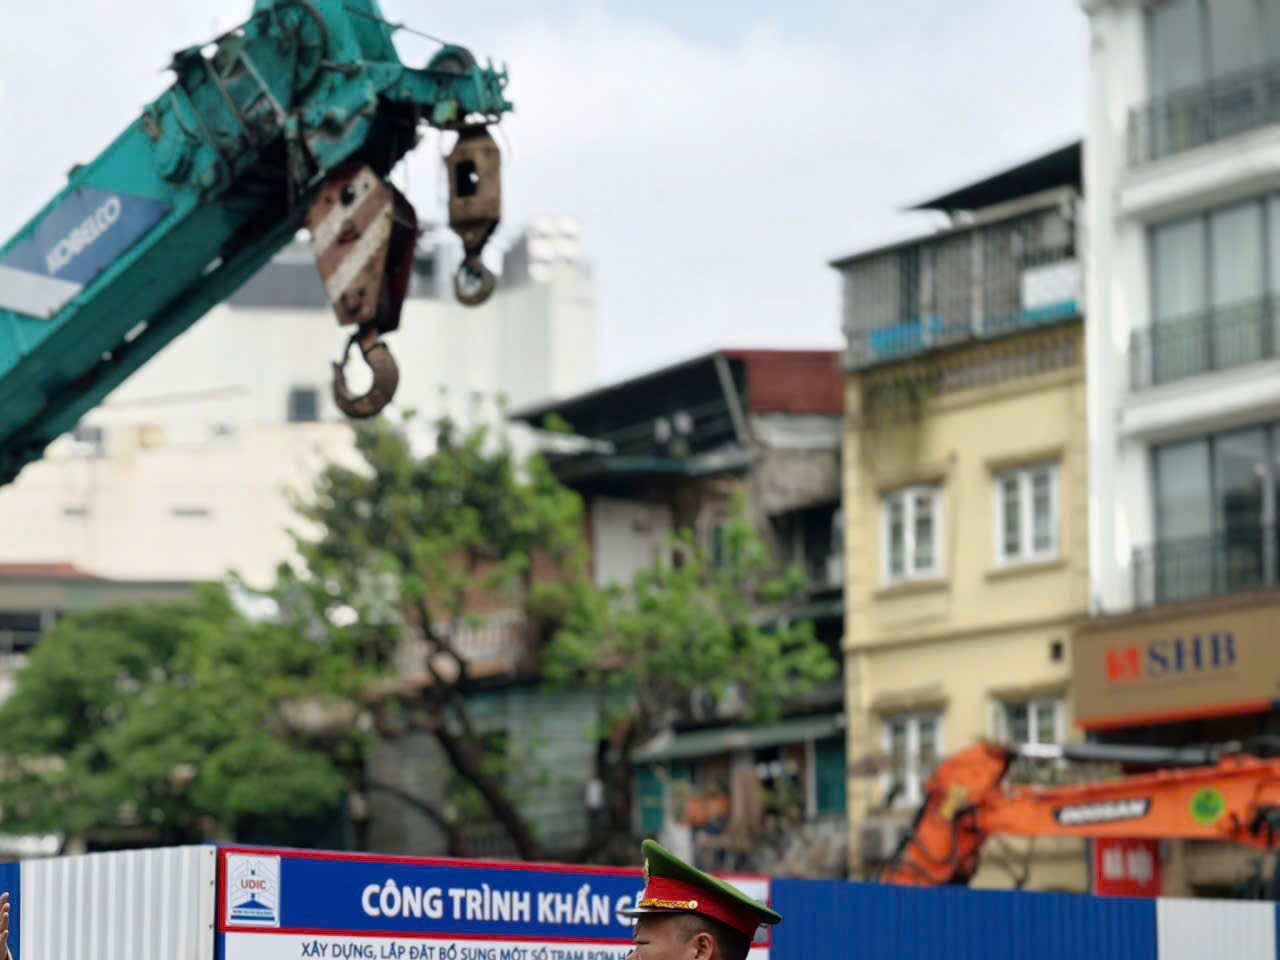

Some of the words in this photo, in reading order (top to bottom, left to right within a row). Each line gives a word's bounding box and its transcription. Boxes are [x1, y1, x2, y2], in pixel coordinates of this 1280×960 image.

[46, 196, 122, 273] KOBELCO
[1147, 631, 1236, 677] SHB
[240, 879, 266, 890] UDIC
[361, 878, 443, 919] CÔNG
[448, 882, 530, 923] TRÌNH
[301, 940, 328, 957] XÂY
[332, 943, 377, 960] DỰNG,
